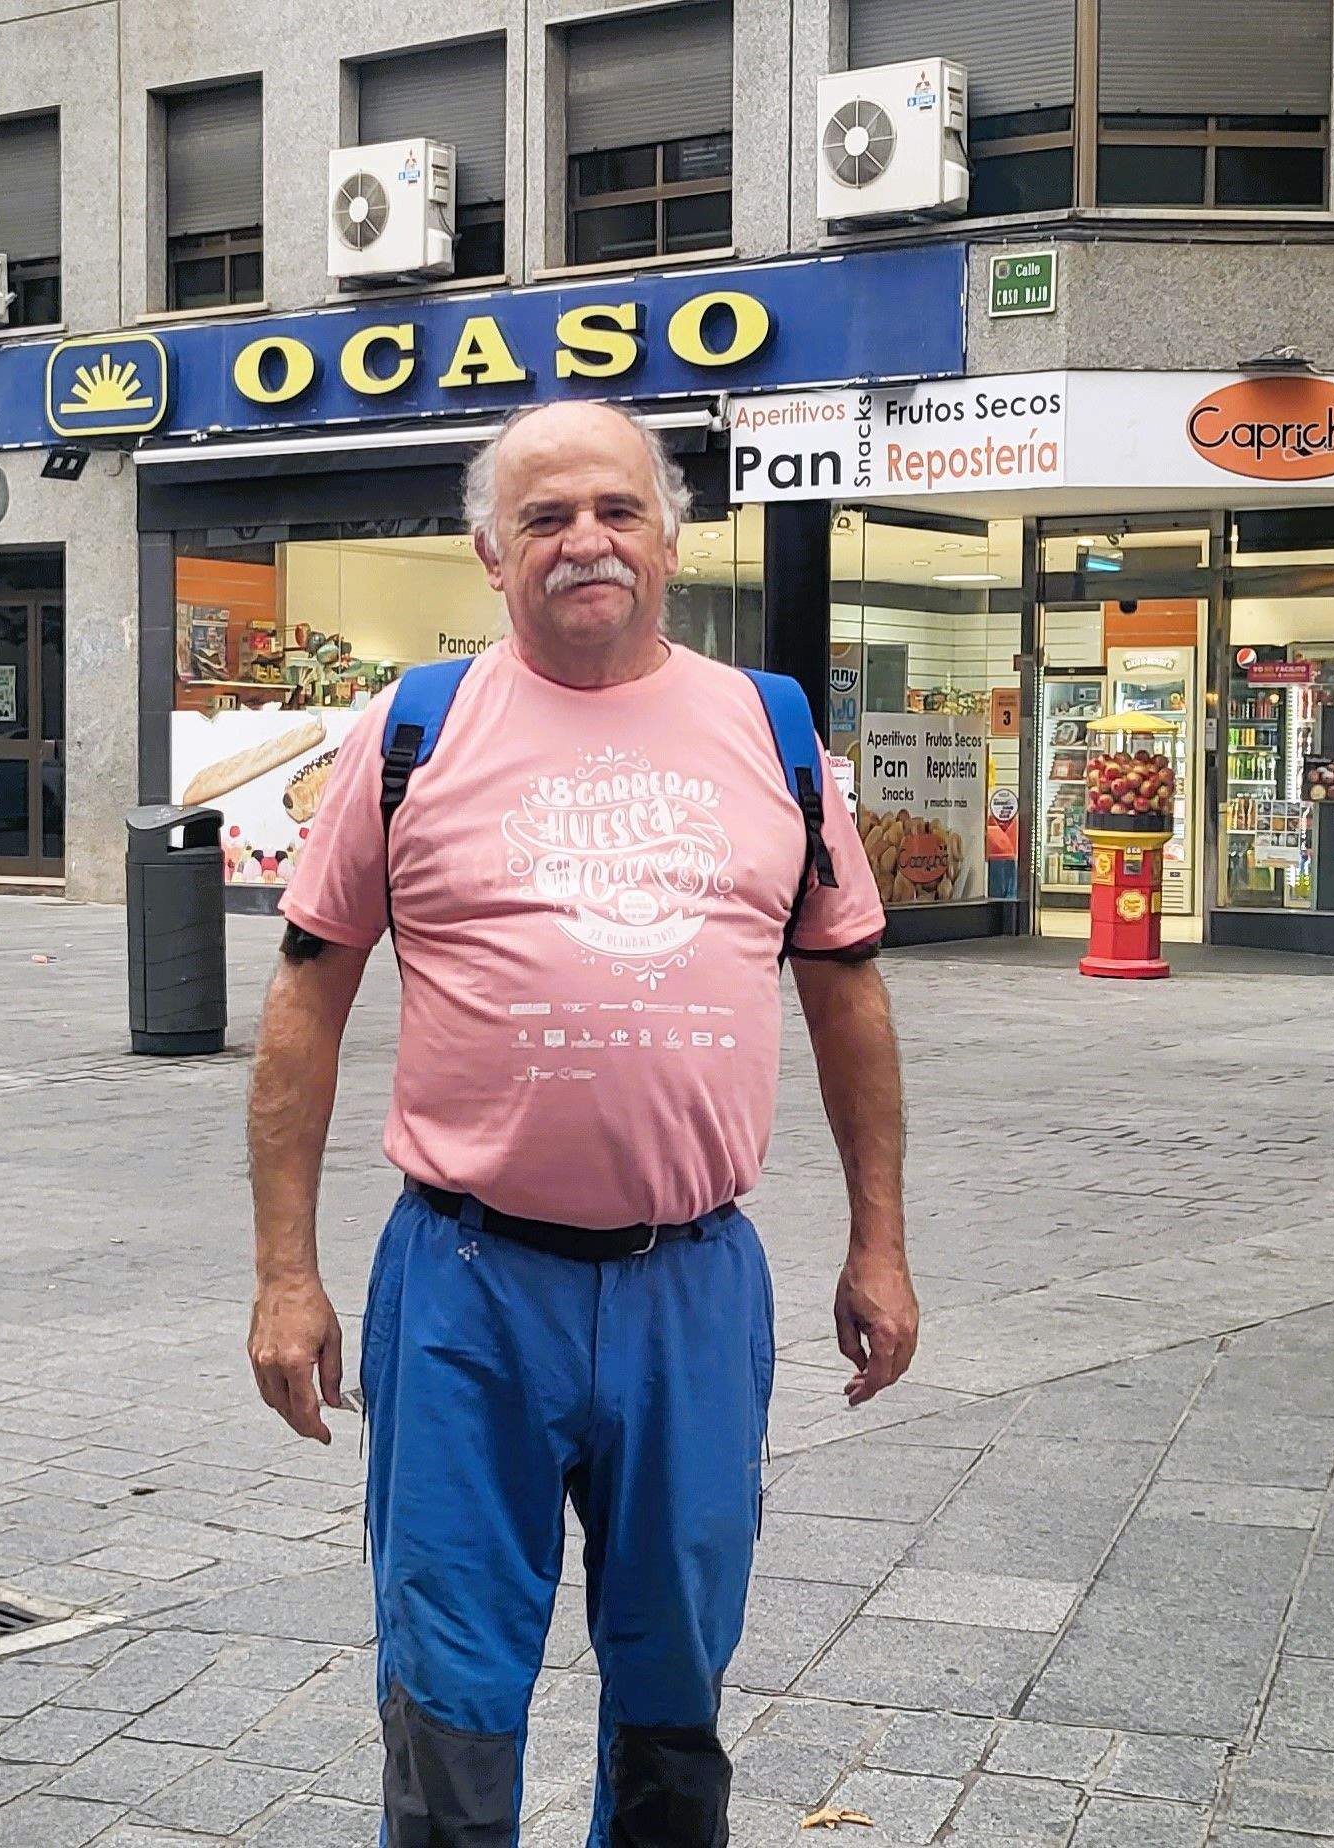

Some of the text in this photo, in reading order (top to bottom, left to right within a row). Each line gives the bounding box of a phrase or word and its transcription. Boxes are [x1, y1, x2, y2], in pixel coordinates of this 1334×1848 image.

[1015, 262, 1041, 277] Calle
[996, 285, 1048, 306] COSO BAJO
[233, 290, 771, 404] OCASO
[734, 400, 846, 432] Aperitivos
[885, 393, 1061, 427] Frutos Secos
[854, 394, 872, 488] Snacks
[735, 444, 842, 491] Pan
[886, 428, 1058, 489] Repostería
[1003, 710, 1011, 726] 3
[867, 730, 917, 749] Aperitivos
[925, 731, 983, 748] Frutos Secos
[873, 754, 908, 778] Pan
[926, 753, 977, 783] Repostería
[881, 787, 915, 801] Snacks
